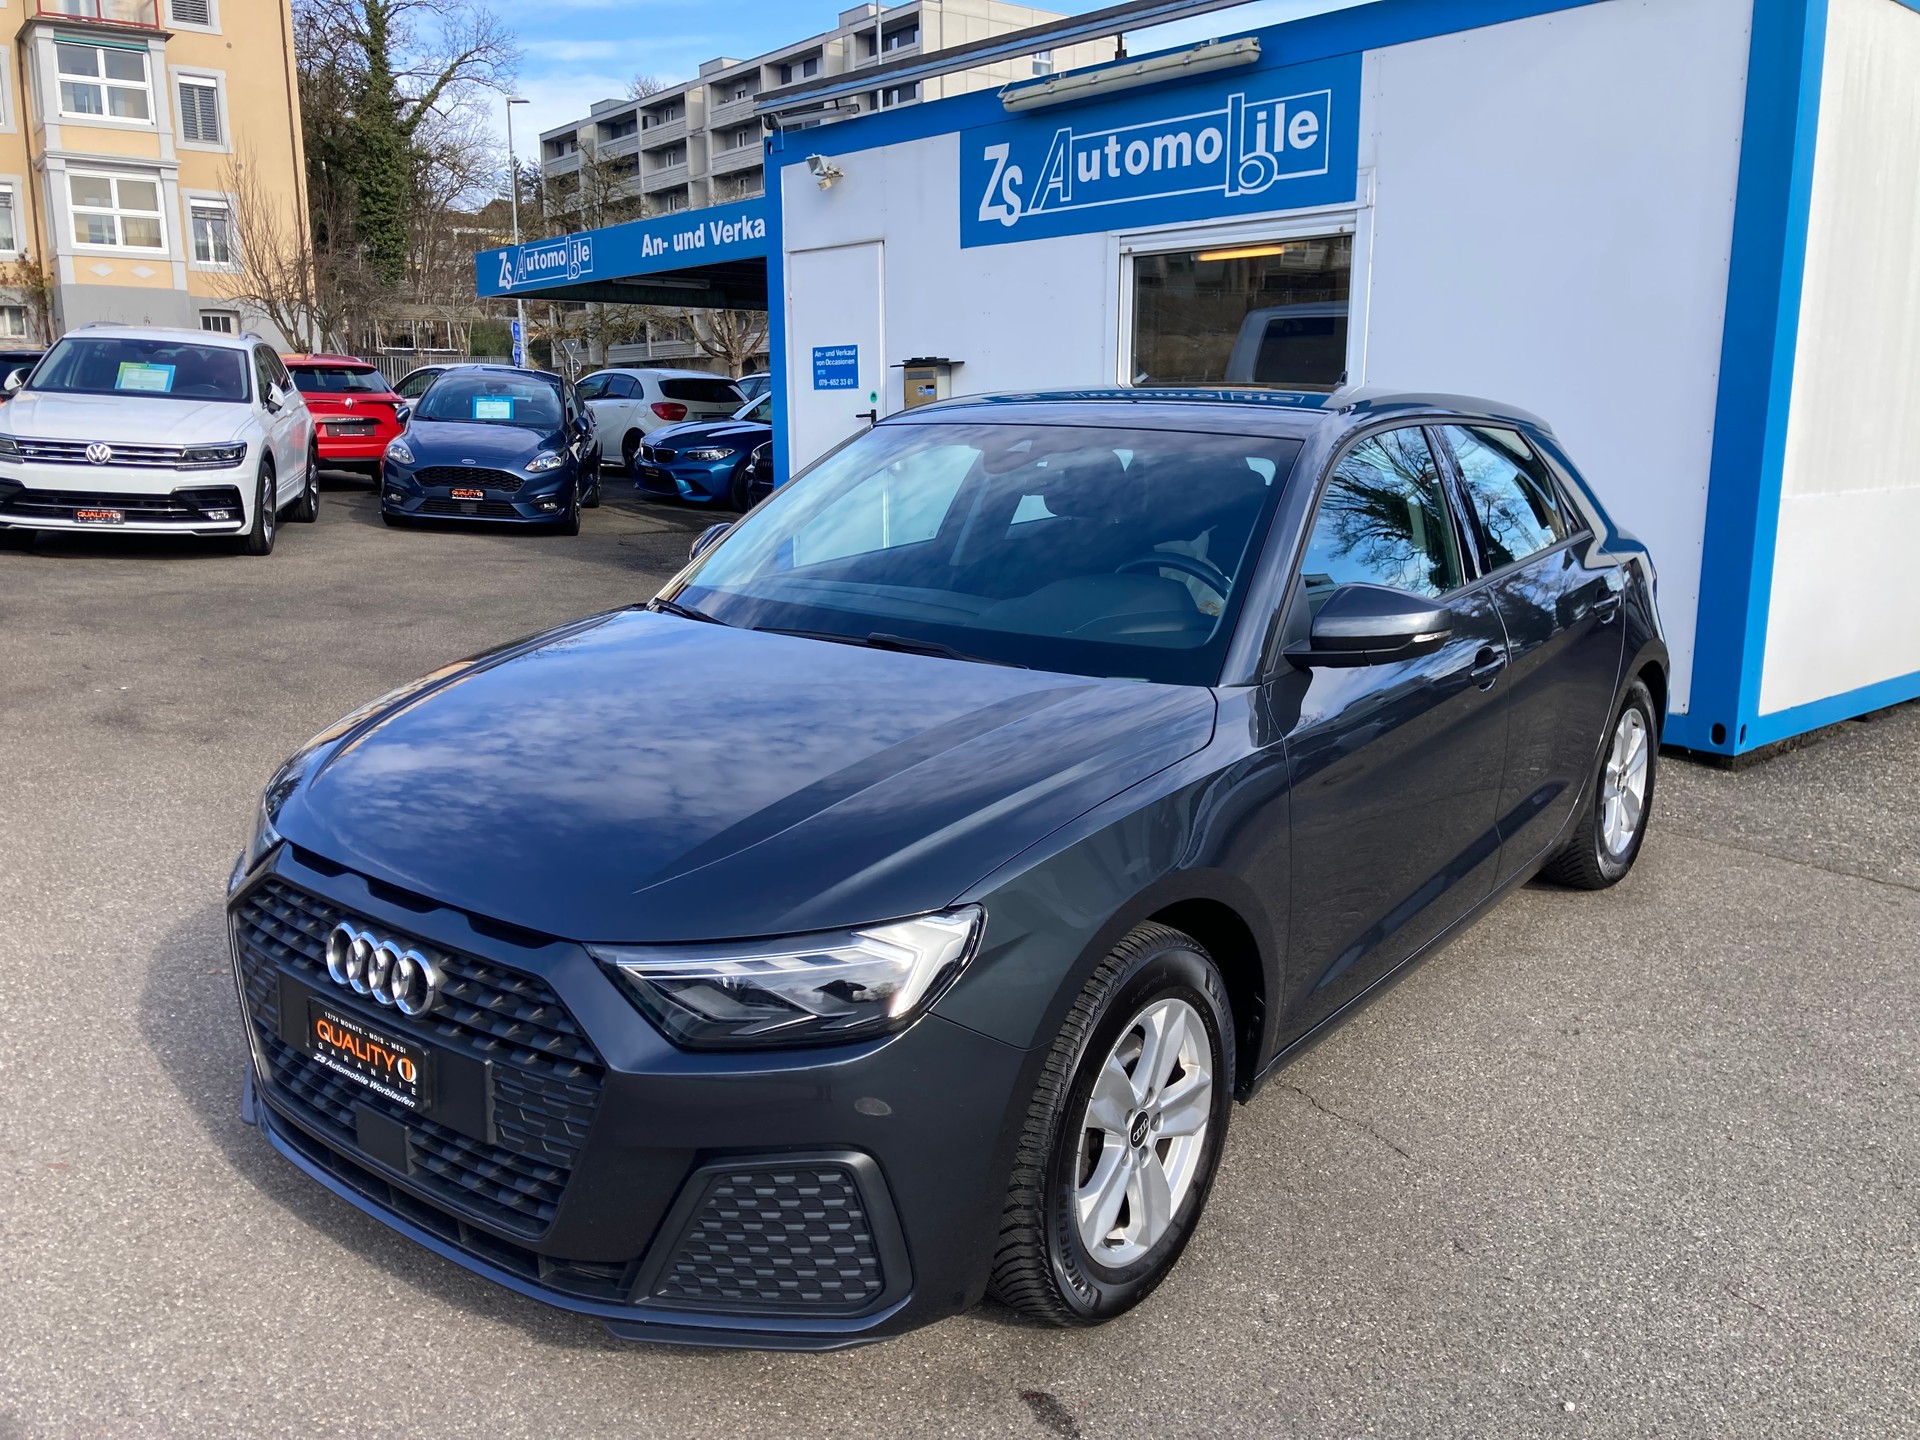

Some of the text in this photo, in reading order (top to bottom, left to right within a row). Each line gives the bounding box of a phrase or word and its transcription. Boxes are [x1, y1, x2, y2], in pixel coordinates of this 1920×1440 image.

[1027, 92, 1320, 214] Automobile
[641, 233, 669, 258] An-
[673, 225, 705, 251] und
[836, 348, 856, 356] Verkauf
[324, 1011, 339, 1023] 12/24
[340, 1019, 362, 1035] MONATE
[369, 1032, 384, 1044] MOIS
[391, 1042, 406, 1054] MESI
[313, 1053, 416, 1108] ZS Automobile Worblaufen
[1058, 1193, 1086, 1292] MICHELIN
